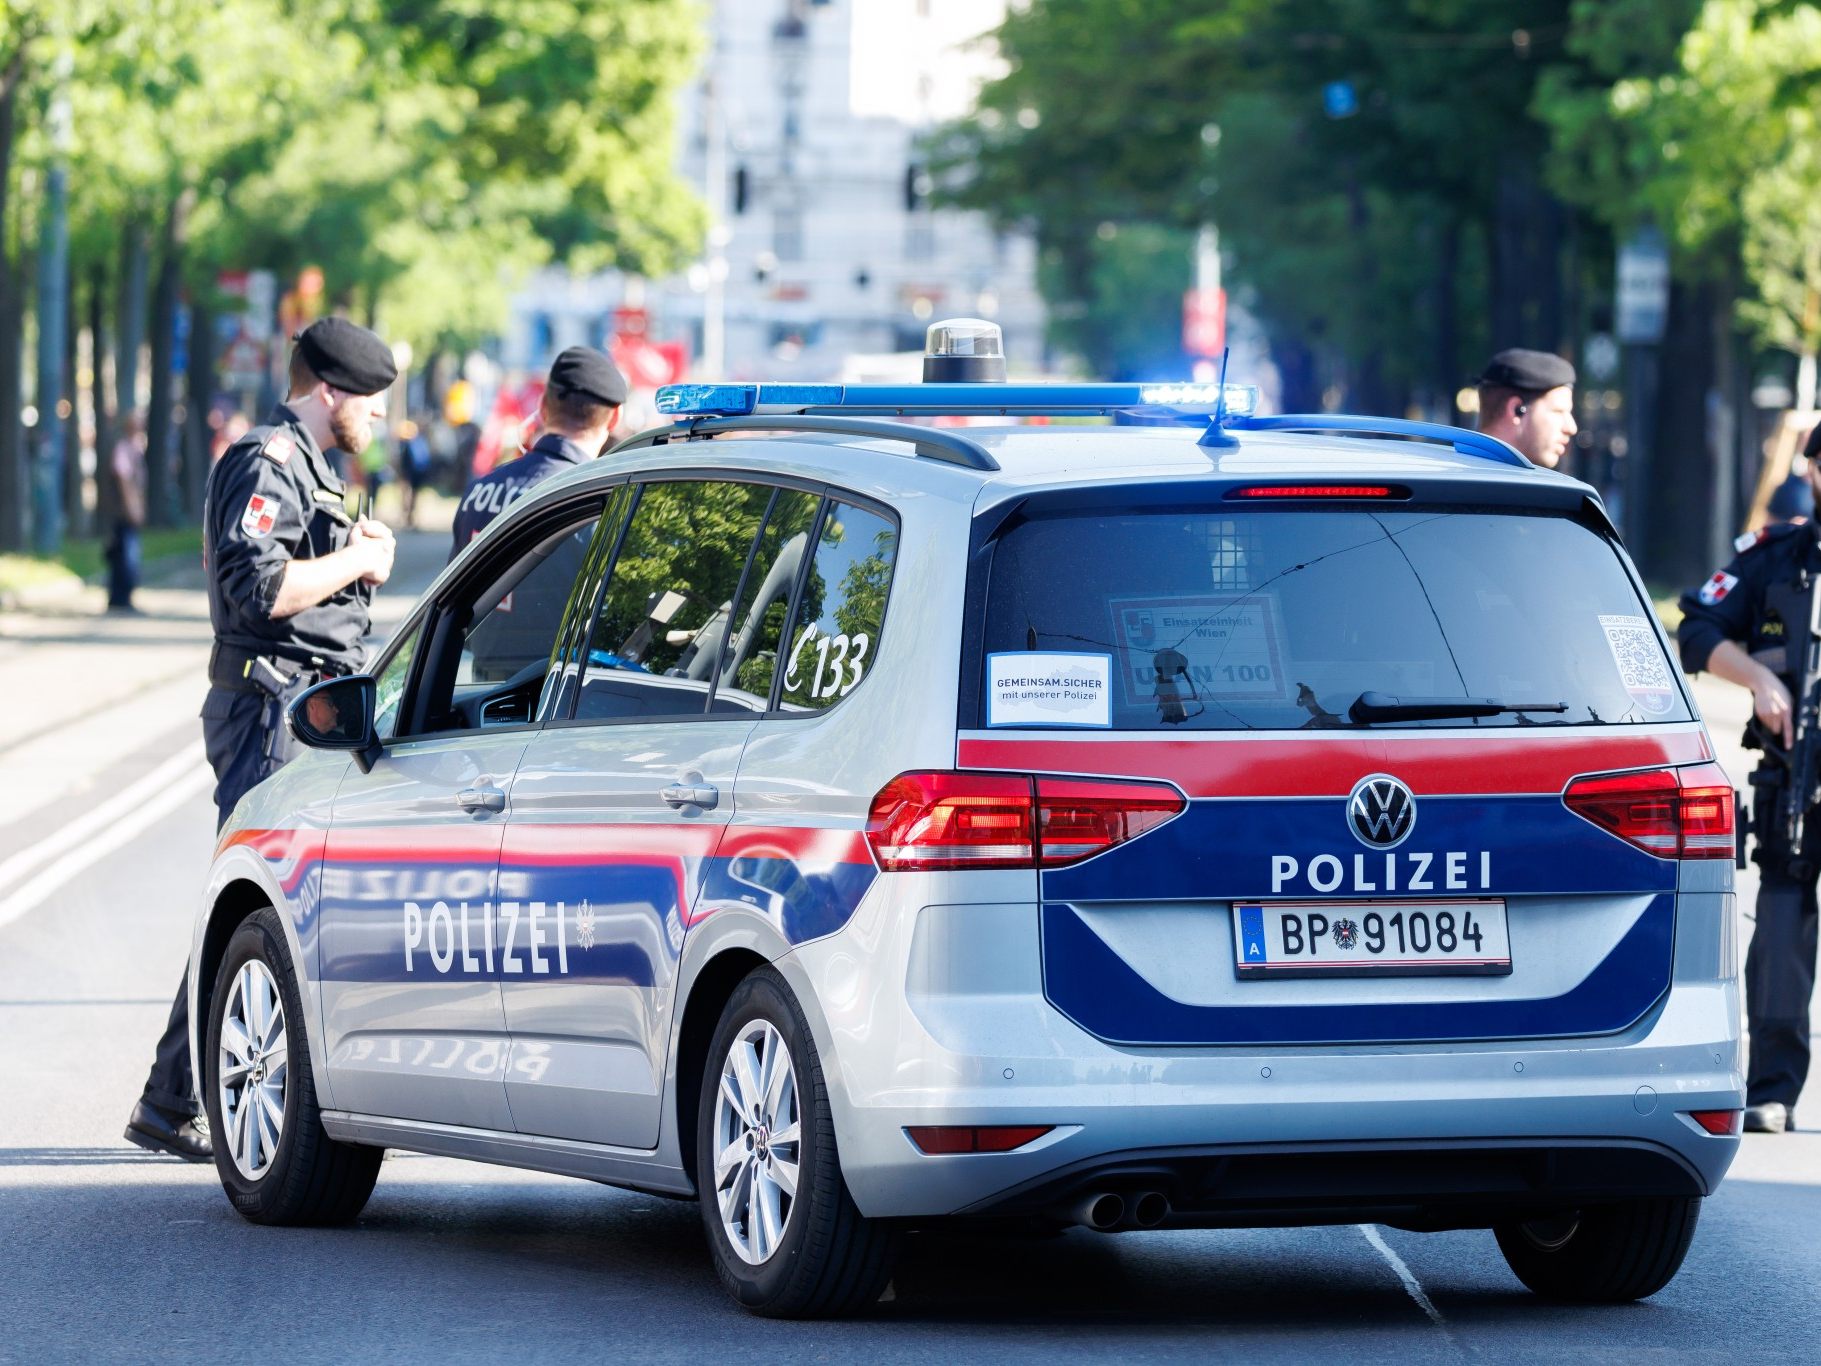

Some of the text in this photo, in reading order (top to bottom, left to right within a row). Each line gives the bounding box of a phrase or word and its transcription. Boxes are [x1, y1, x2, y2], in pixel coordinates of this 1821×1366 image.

[1163, 616, 1253, 627] Einsatzeinheit
[1196, 628, 1227, 638] Wien
[811, 633, 869, 698] 133
[997, 678, 1102, 689] GEMEINSAM.SICHER
[1135, 664, 1271, 686] UN 100
[1002, 690, 1098, 700] mit unserer Polizei
[1271, 851, 1490, 893] POLIZEI
[404, 901, 568, 974] POLIZEI
[1281, 911, 1483, 955] BP 91084
[1249, 942, 1260, 956] A
